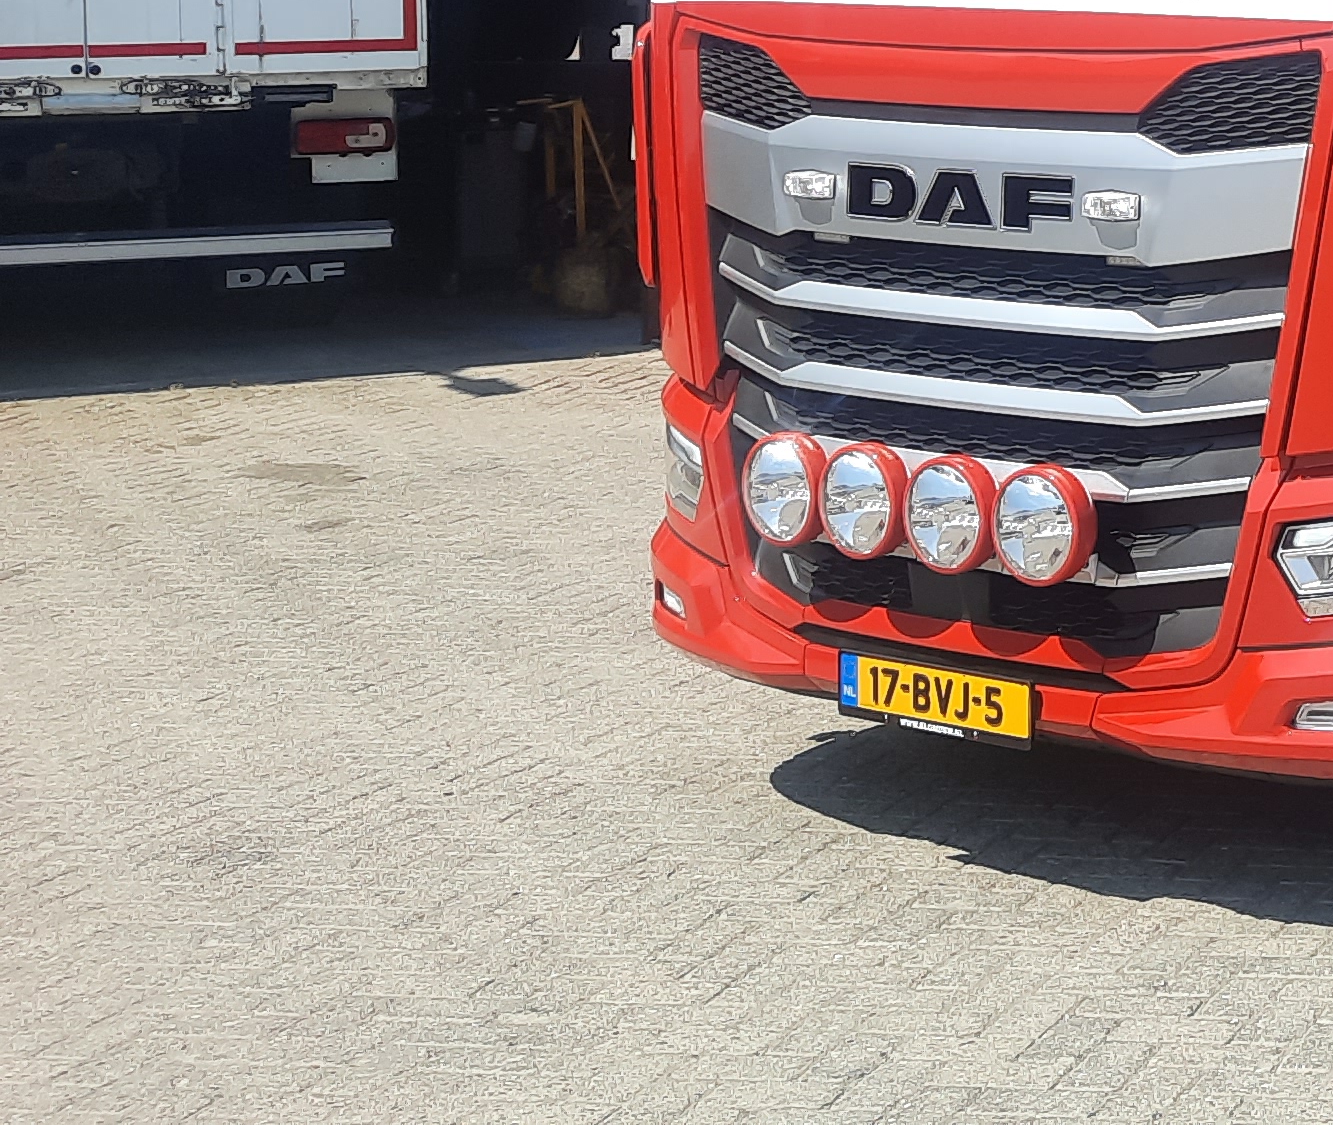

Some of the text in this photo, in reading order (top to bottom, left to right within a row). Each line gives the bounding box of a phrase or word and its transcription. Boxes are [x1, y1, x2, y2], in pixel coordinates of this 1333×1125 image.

[846, 161, 1075, 233] DAF
[226, 261, 346, 289] DAF
[843, 684, 857, 698] NL
[869, 666, 1003, 727] 17-BVJ-5
